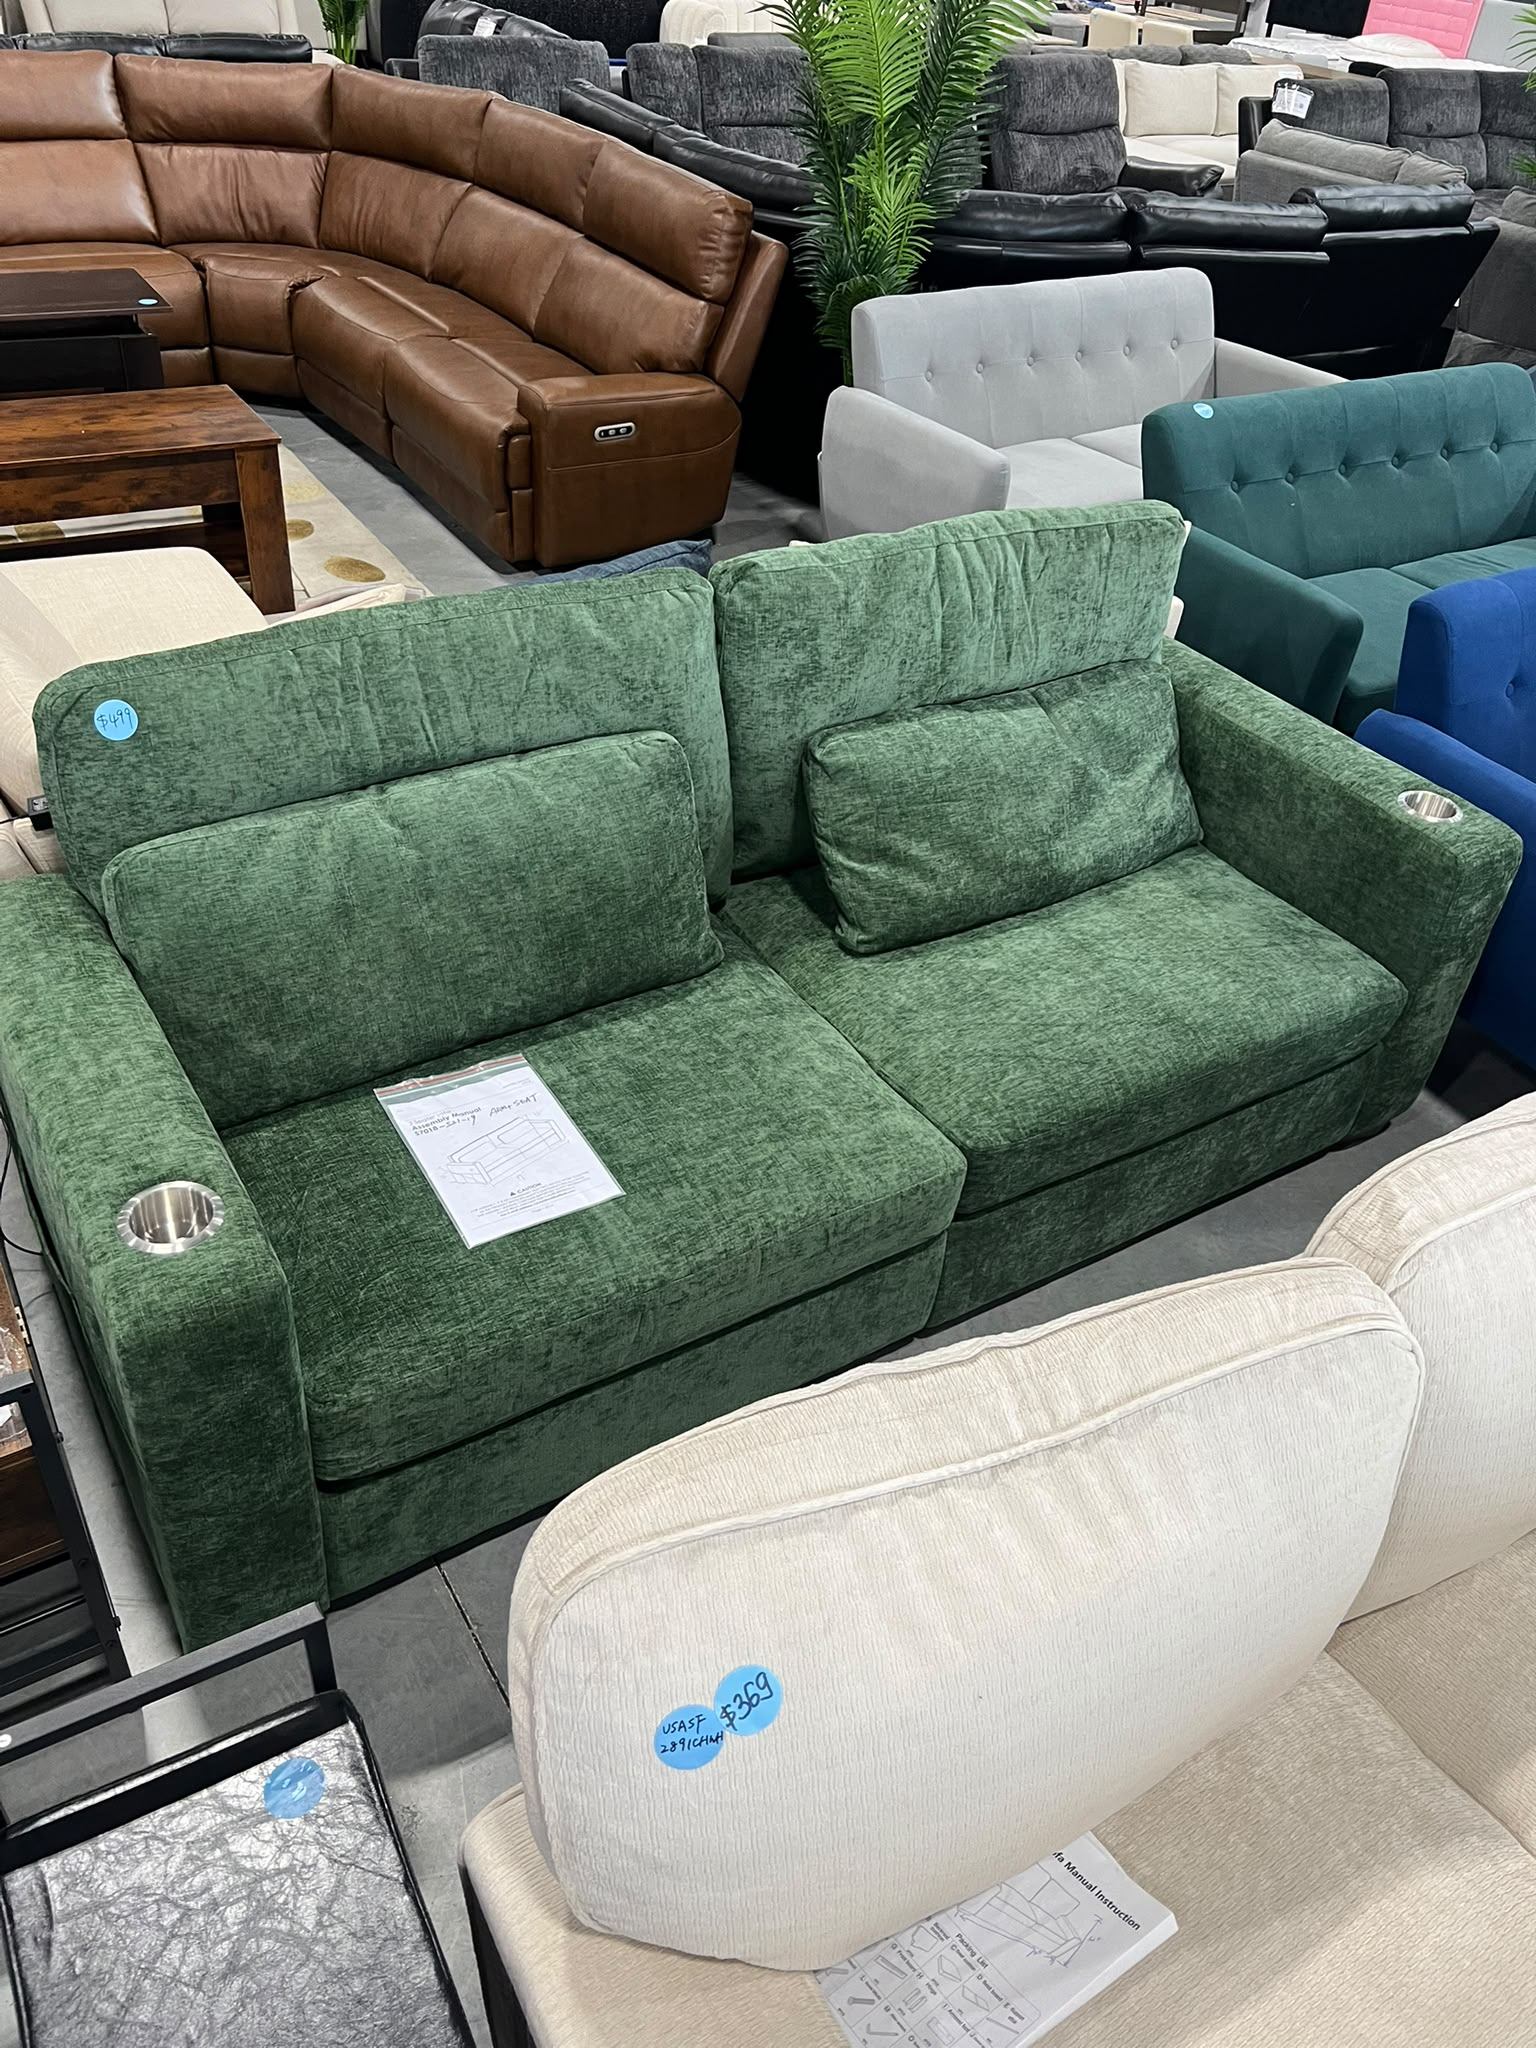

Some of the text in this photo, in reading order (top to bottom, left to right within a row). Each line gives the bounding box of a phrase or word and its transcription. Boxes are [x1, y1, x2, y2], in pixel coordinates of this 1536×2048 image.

[96, 708, 133, 731] $499
[412, 1106, 482, 1131] Assembly Manual
[720, 1671, 774, 1731] $369
[1063, 1861, 1098, 1893] Manual
[1094, 1889, 1141, 1931] Instruction
[955, 1932, 977, 1957] Packing
[976, 1955, 989, 1969] List
